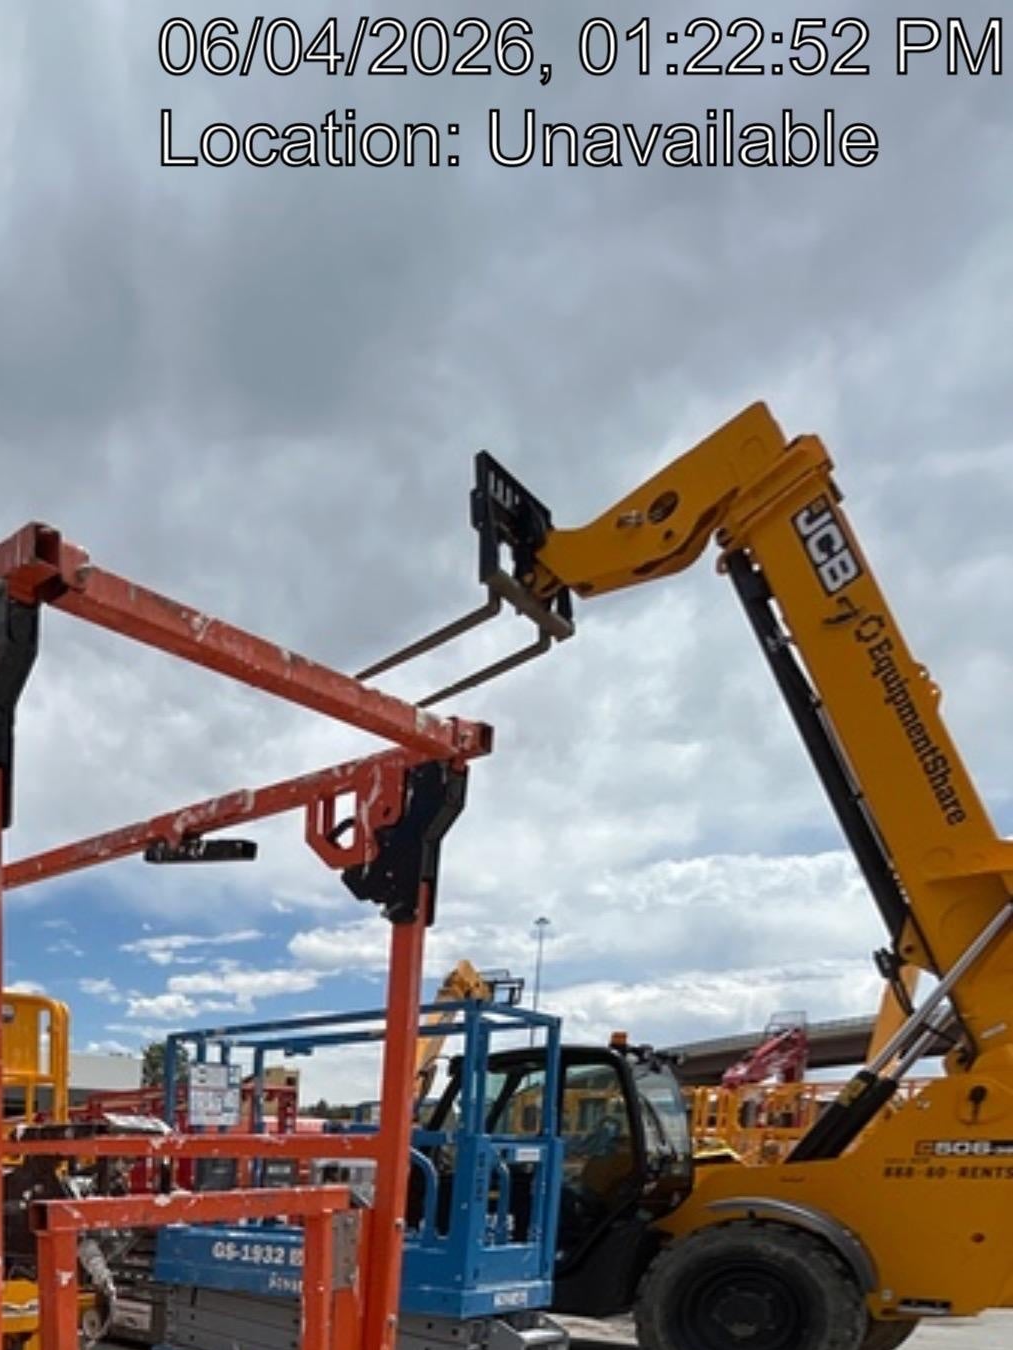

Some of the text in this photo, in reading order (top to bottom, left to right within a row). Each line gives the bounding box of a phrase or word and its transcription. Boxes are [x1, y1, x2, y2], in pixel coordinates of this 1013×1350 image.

[794, 508, 860, 593] JCB
[867, 637, 967, 827] EquipmentShare
[211, 1241, 285, 1265] GS-1932
